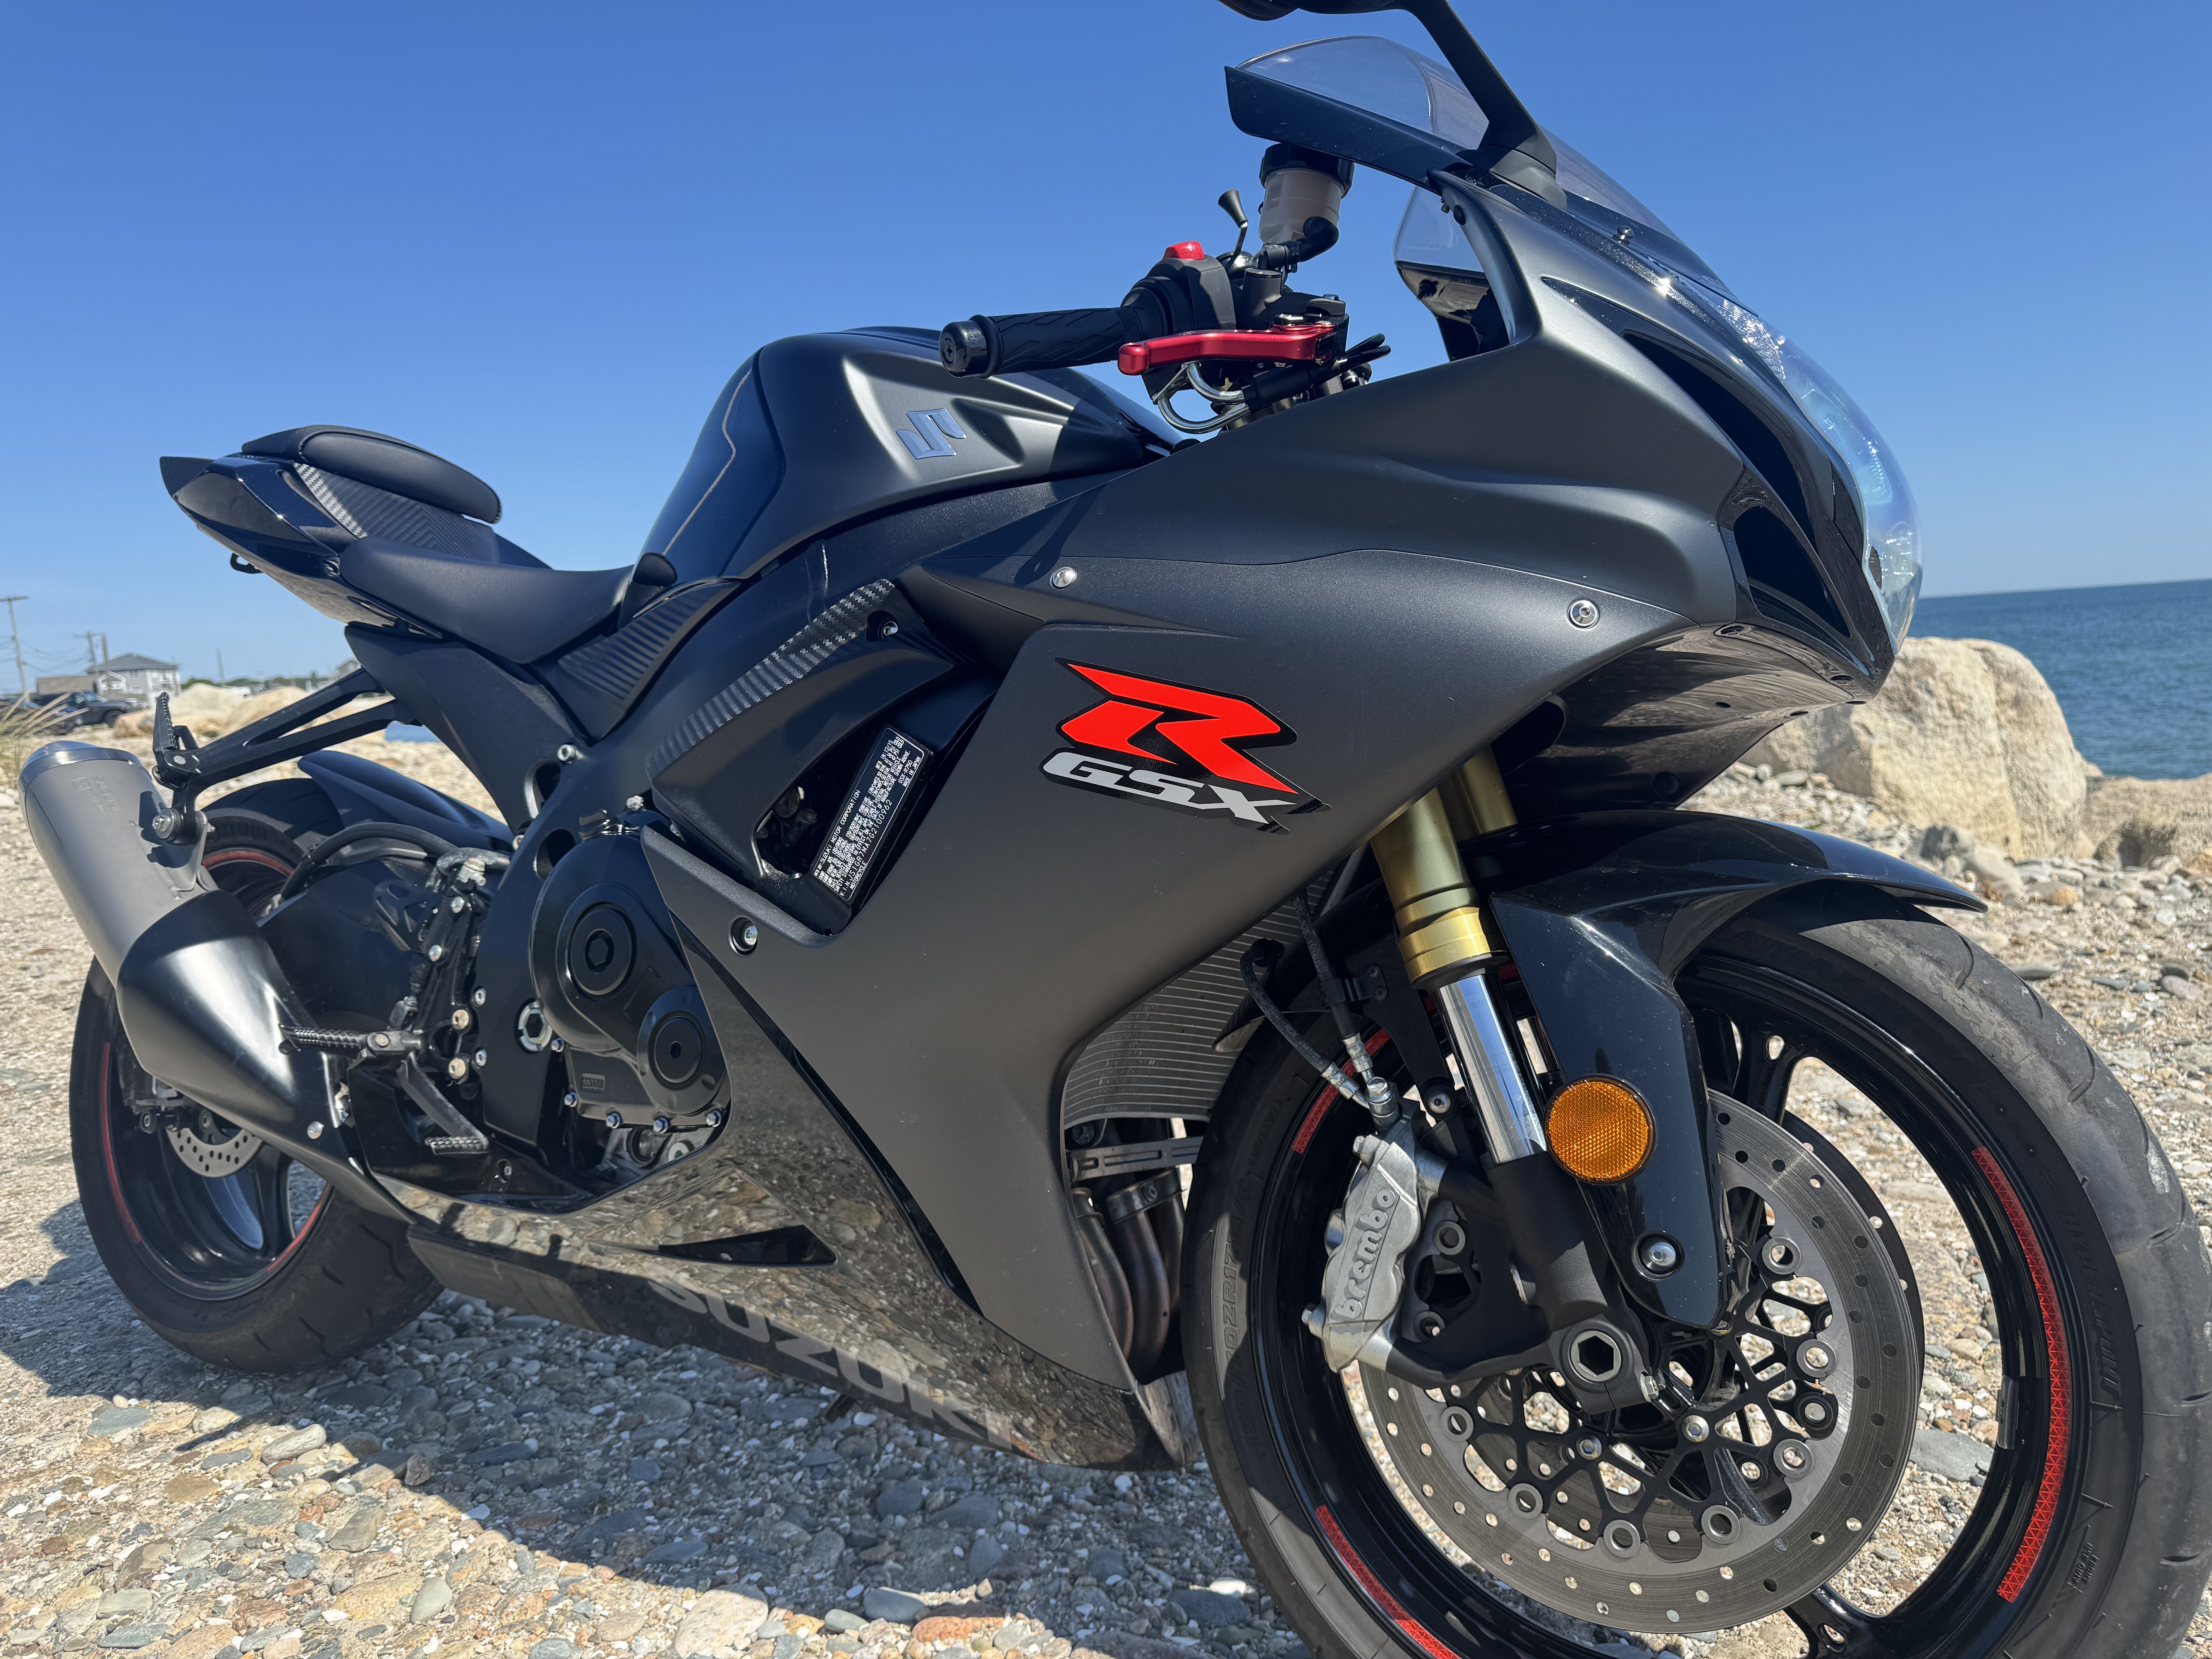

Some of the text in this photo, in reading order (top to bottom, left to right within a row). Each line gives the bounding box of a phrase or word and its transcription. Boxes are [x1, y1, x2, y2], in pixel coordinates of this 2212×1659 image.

[898, 760, 912, 783] GSX-R750
[1043, 752, 1297, 824] GSX
[1062, 664, 1298, 794] R
[830, 826, 842, 843] MOTOR
[840, 789, 860, 824] CORPORATION
[830, 878, 838, 890] THIS
[835, 861, 847, 879] VEHICLE
[844, 842, 857, 862] CONFORMS
[862, 803, 877, 828] APPLICABLE
[874, 788, 886, 804] FEDERAL
[883, 773, 892, 787] MOTOR
[890, 756, 901, 773] VEHICLE
[834, 877, 844, 892] SAFETY
[842, 856, 855, 878] STANDARDS
[855, 834, 866, 850] EFFECT
[871, 809, 880, 820] DATE
[880, 776, 896, 802] MANUFACTURE
[849, 860, 867, 890] MOTORCYCLE
[902, 776, 910, 787] MADE
[912, 756, 921, 769] JAPAN
[1334, 1188, 1396, 1319] brembo
[642, 1261, 1011, 1450] SUZUKI
